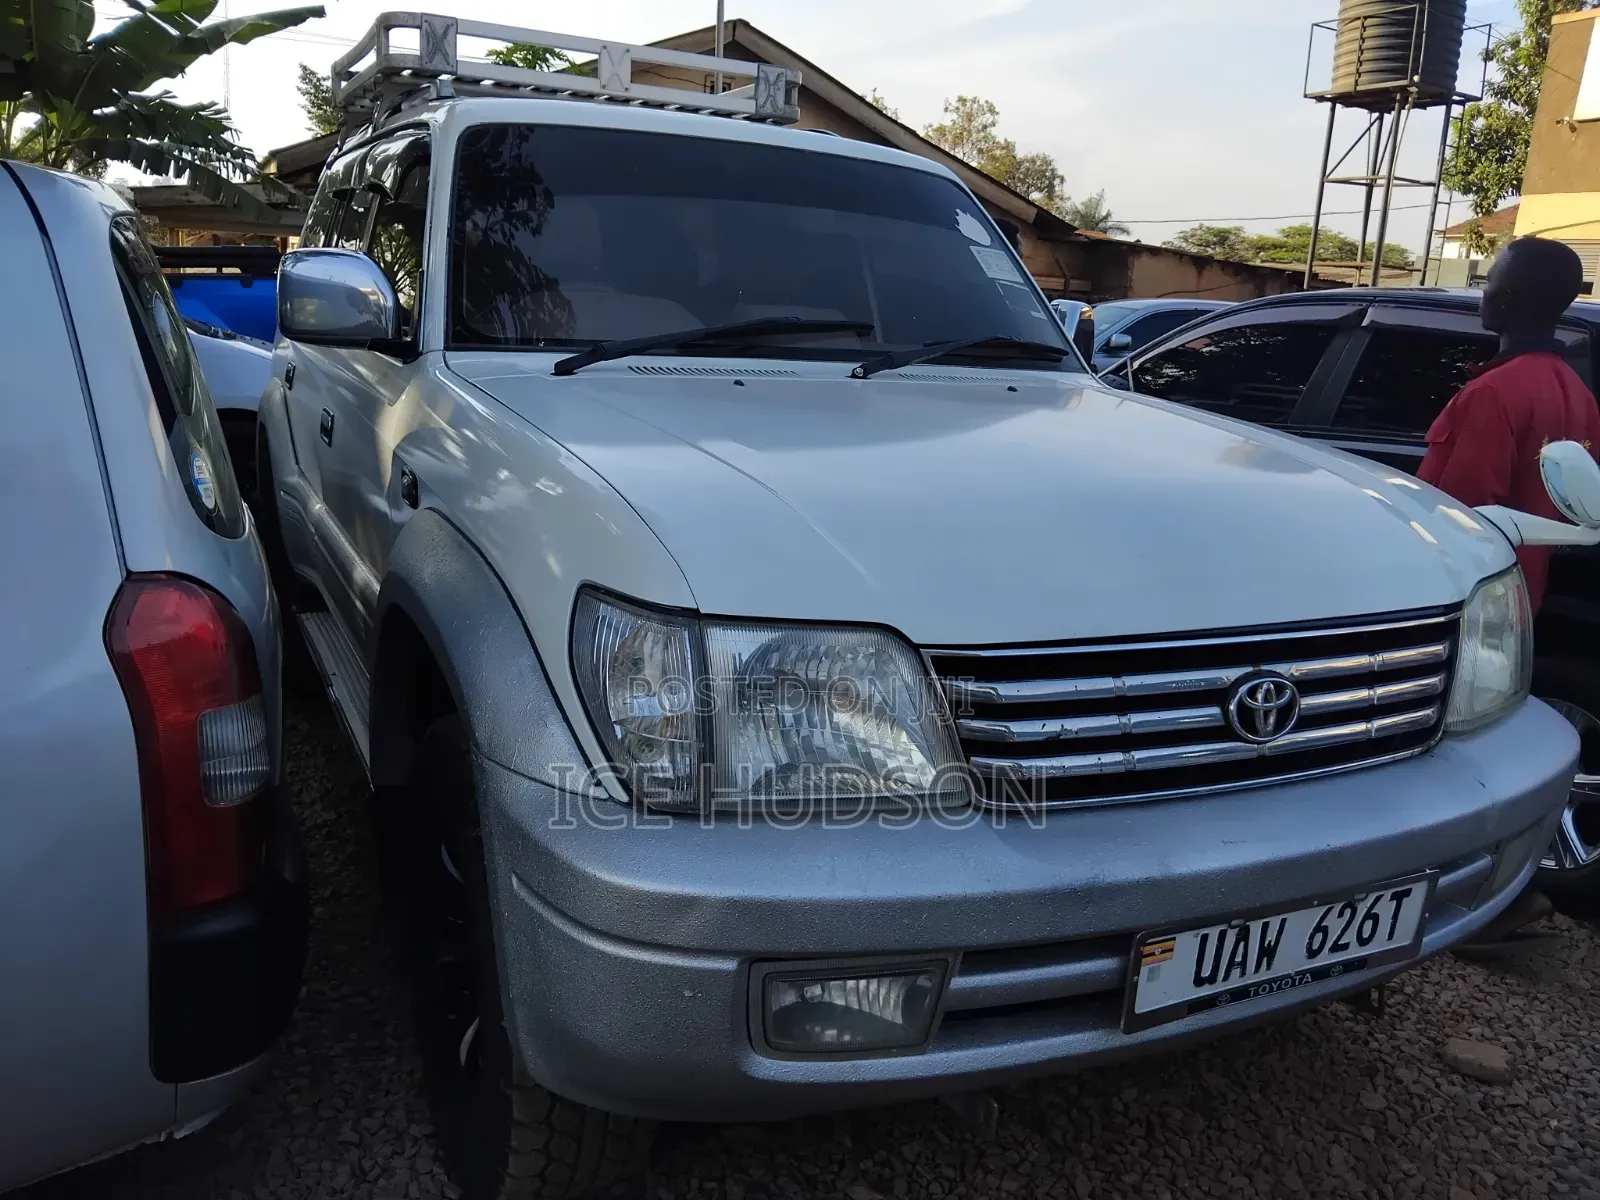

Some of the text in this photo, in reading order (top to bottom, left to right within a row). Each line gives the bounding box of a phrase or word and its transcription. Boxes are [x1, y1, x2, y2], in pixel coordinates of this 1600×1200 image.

[1193, 888, 1412, 987] UAW 626T
[1248, 973, 1312, 998] TOYOTA
